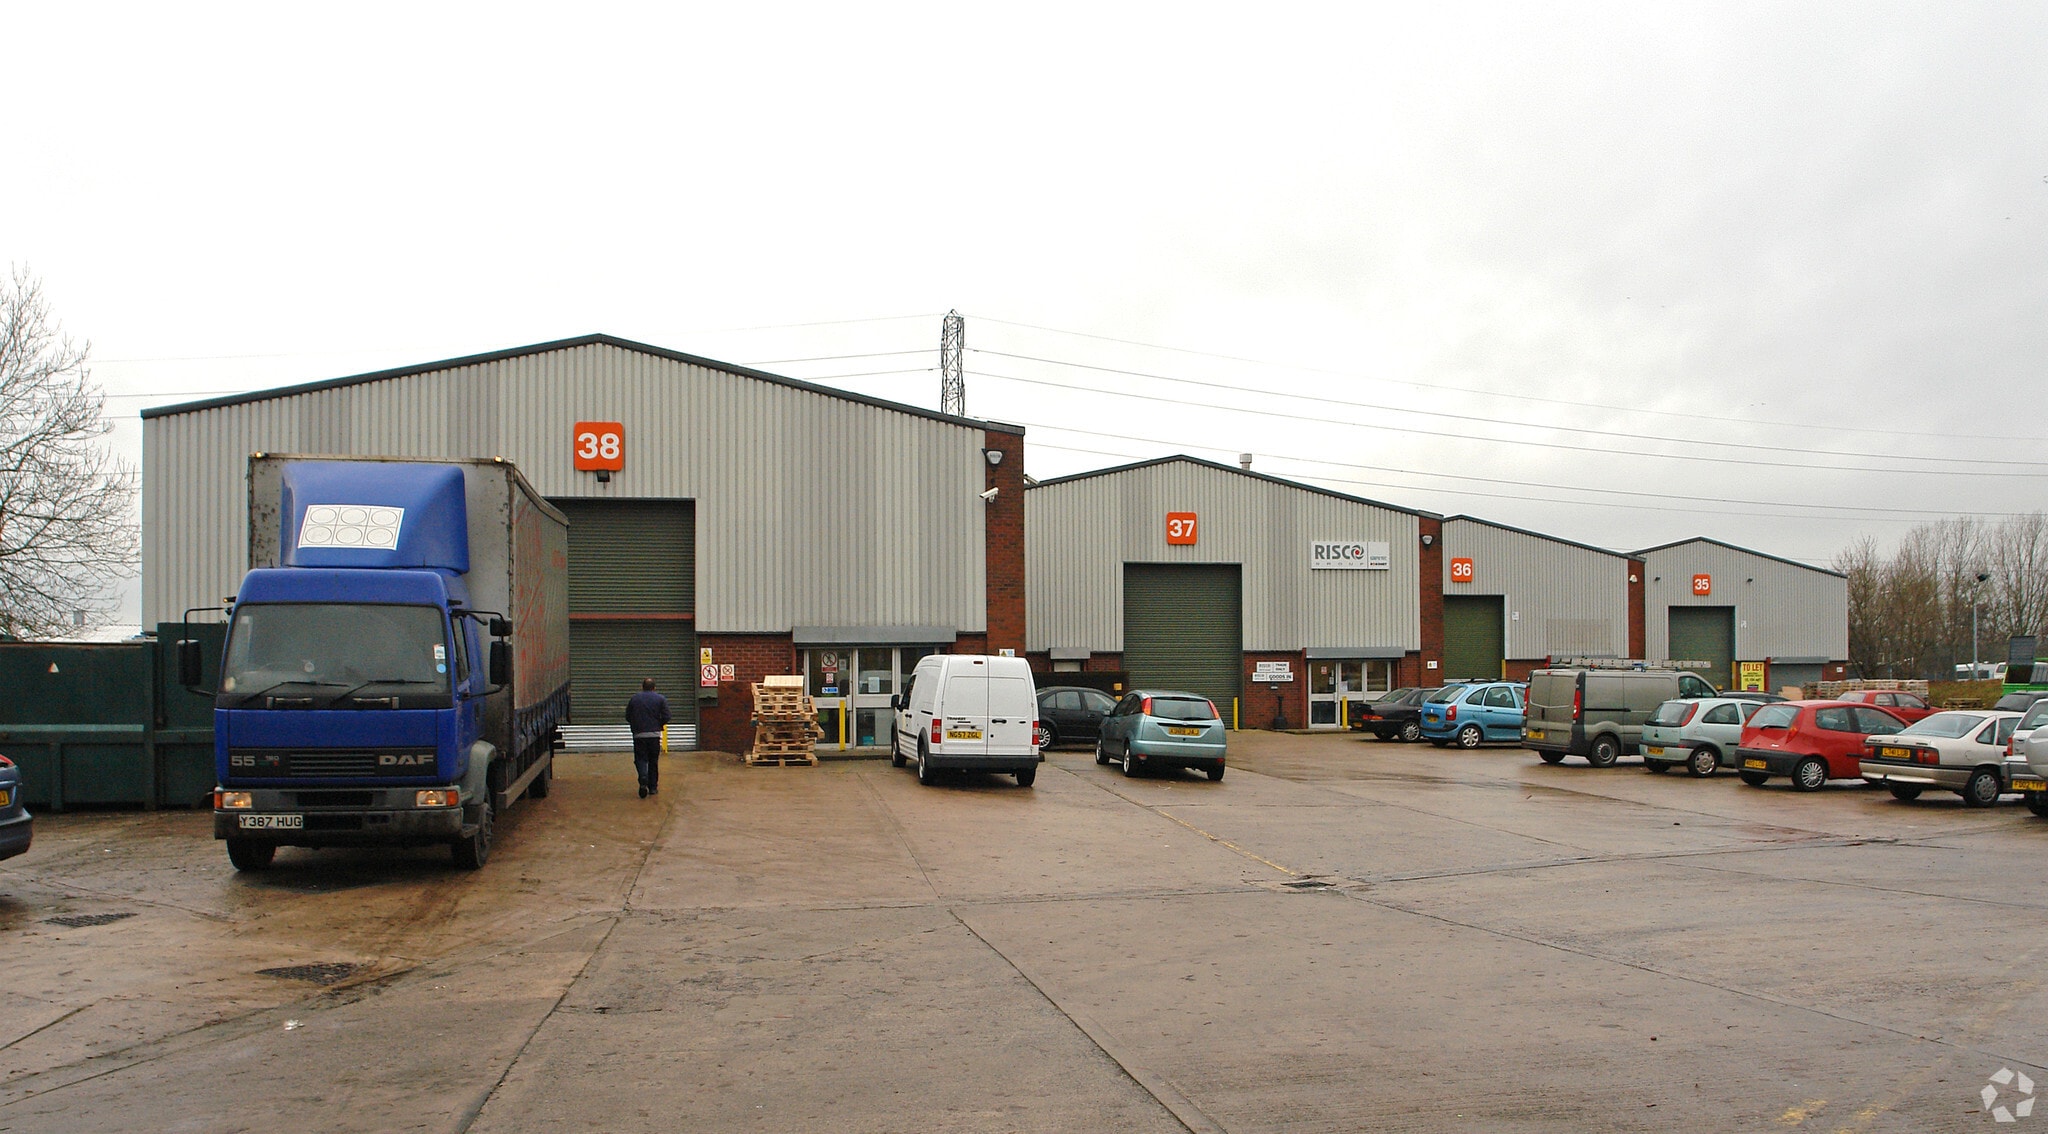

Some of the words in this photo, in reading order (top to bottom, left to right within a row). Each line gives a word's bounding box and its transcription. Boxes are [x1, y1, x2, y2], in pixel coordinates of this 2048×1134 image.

[577, 432, 620, 460] 38
[1169, 519, 1195, 537] 37
[1314, 544, 1364, 560] RISCO
[1453, 562, 1471, 576] 36
[1694, 578, 1709, 590] 35
[1742, 663, 1751, 671] TO
[1752, 663, 1763, 671] LET
[231, 755, 256, 766] 55
[378, 754, 434, 766] DAF
[241, 816, 272, 827] Y387
[276, 816, 302, 827] HUG
